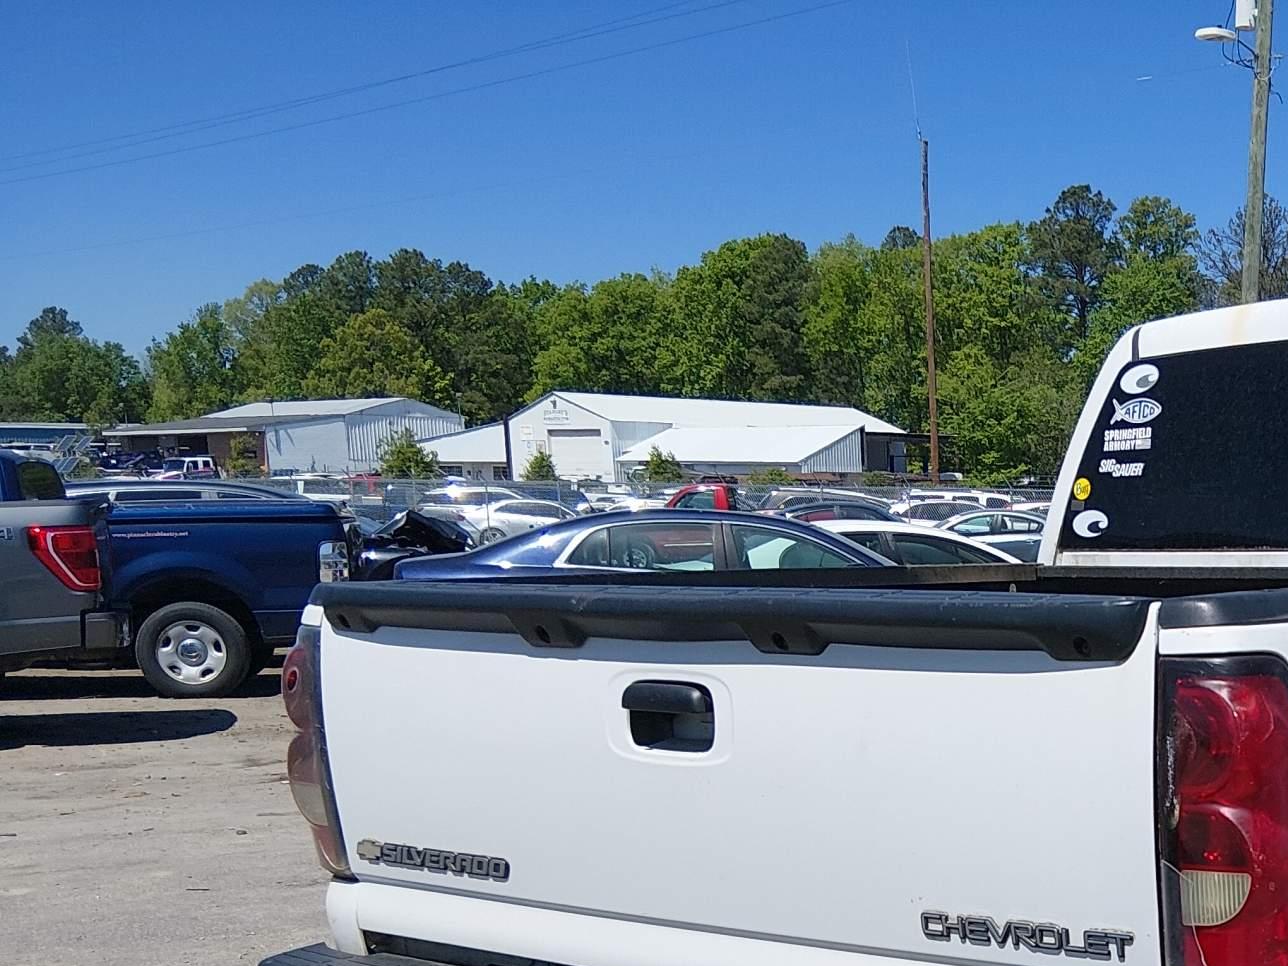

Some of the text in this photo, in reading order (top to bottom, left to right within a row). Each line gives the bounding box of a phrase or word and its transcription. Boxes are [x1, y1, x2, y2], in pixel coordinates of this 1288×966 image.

[1124, 401, 1156, 419] AFTCO
[1104, 427, 1152, 440] SPRINGFIELD
[1103, 440, 1136, 452] ARMORY
[382, 842, 510, 882] SILVERADO
[920, 910, 1134, 963] CHEVROLET
